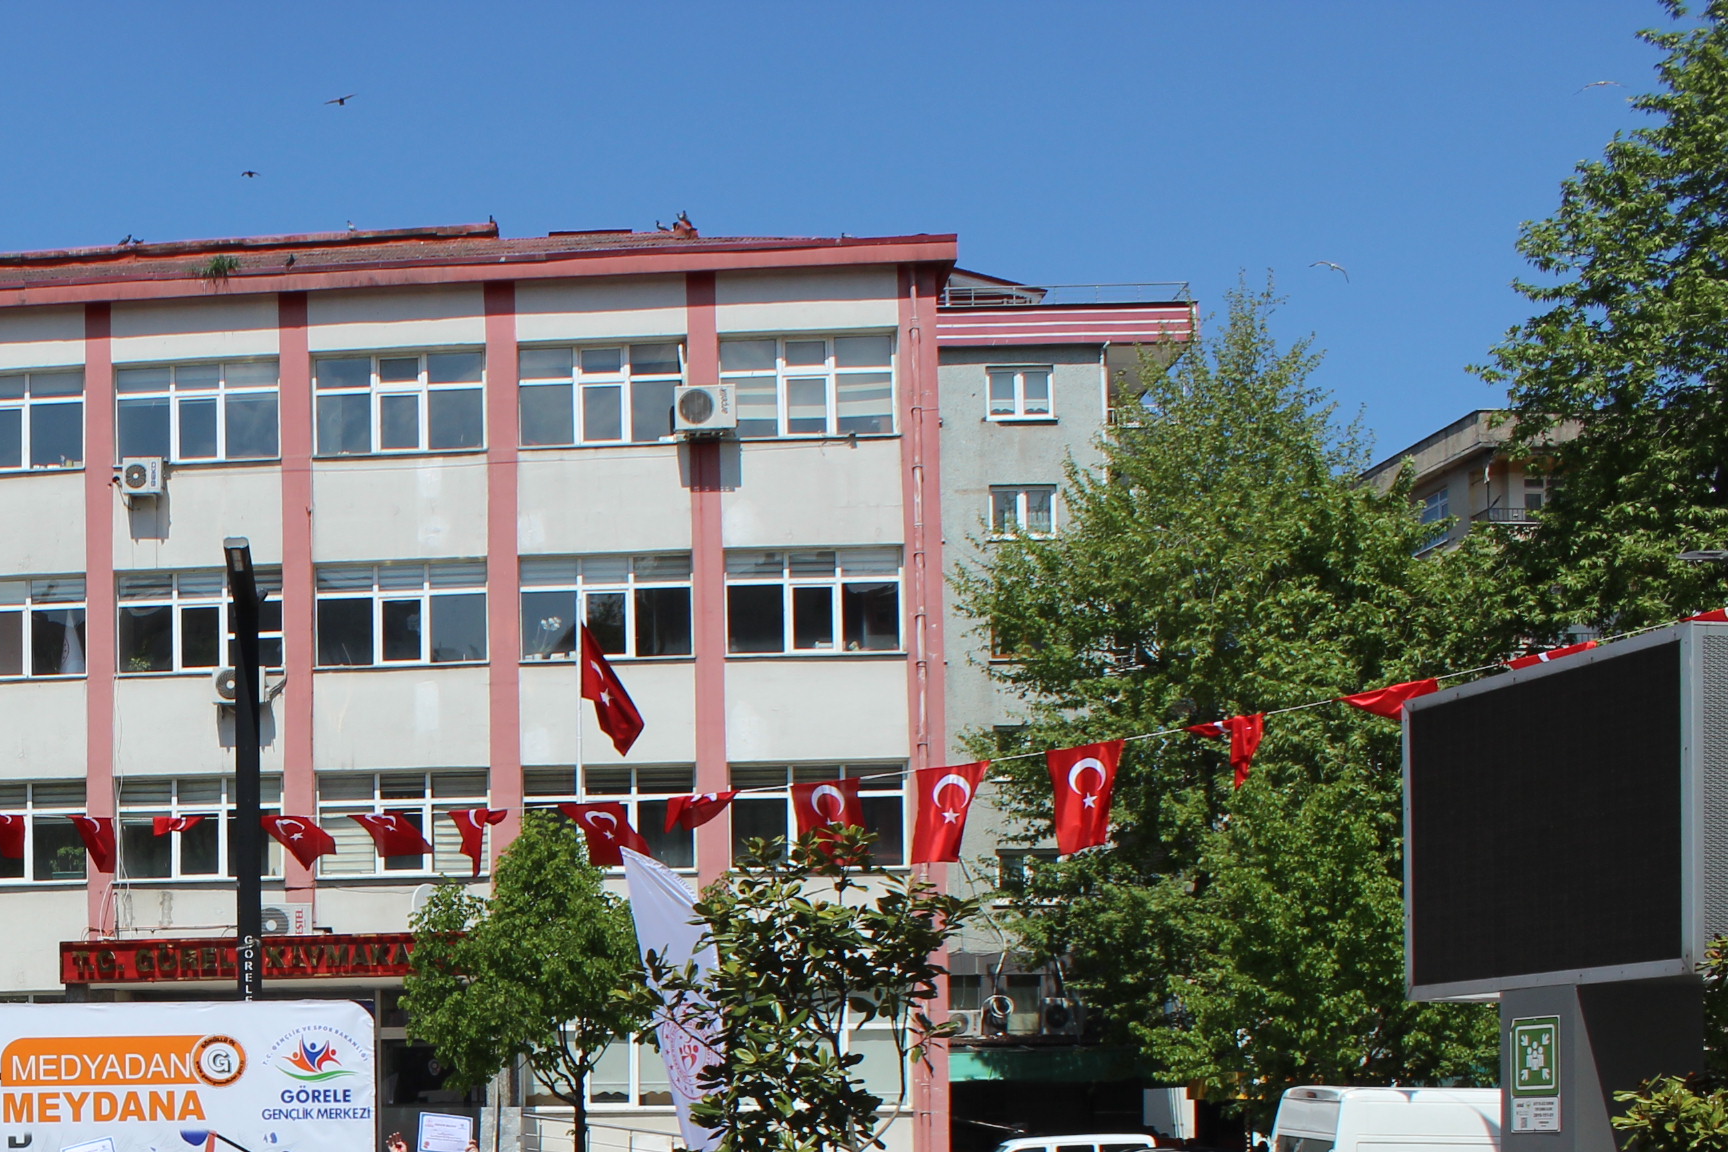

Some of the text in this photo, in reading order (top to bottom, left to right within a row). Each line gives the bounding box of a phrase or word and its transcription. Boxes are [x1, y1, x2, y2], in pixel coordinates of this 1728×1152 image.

[295, 909, 303, 935] ESTEL
[134, 944, 235, 972] GÖREL
[264, 944, 411, 967] KAYMAKA
[12, 1053, 191, 1081] MEDYADAN
[3, 1090, 206, 1123] MEYDANA
[280, 1085, 352, 1104] GÖRELE
[262, 1106, 371, 1121] GENÇLİK MERKEZİ
